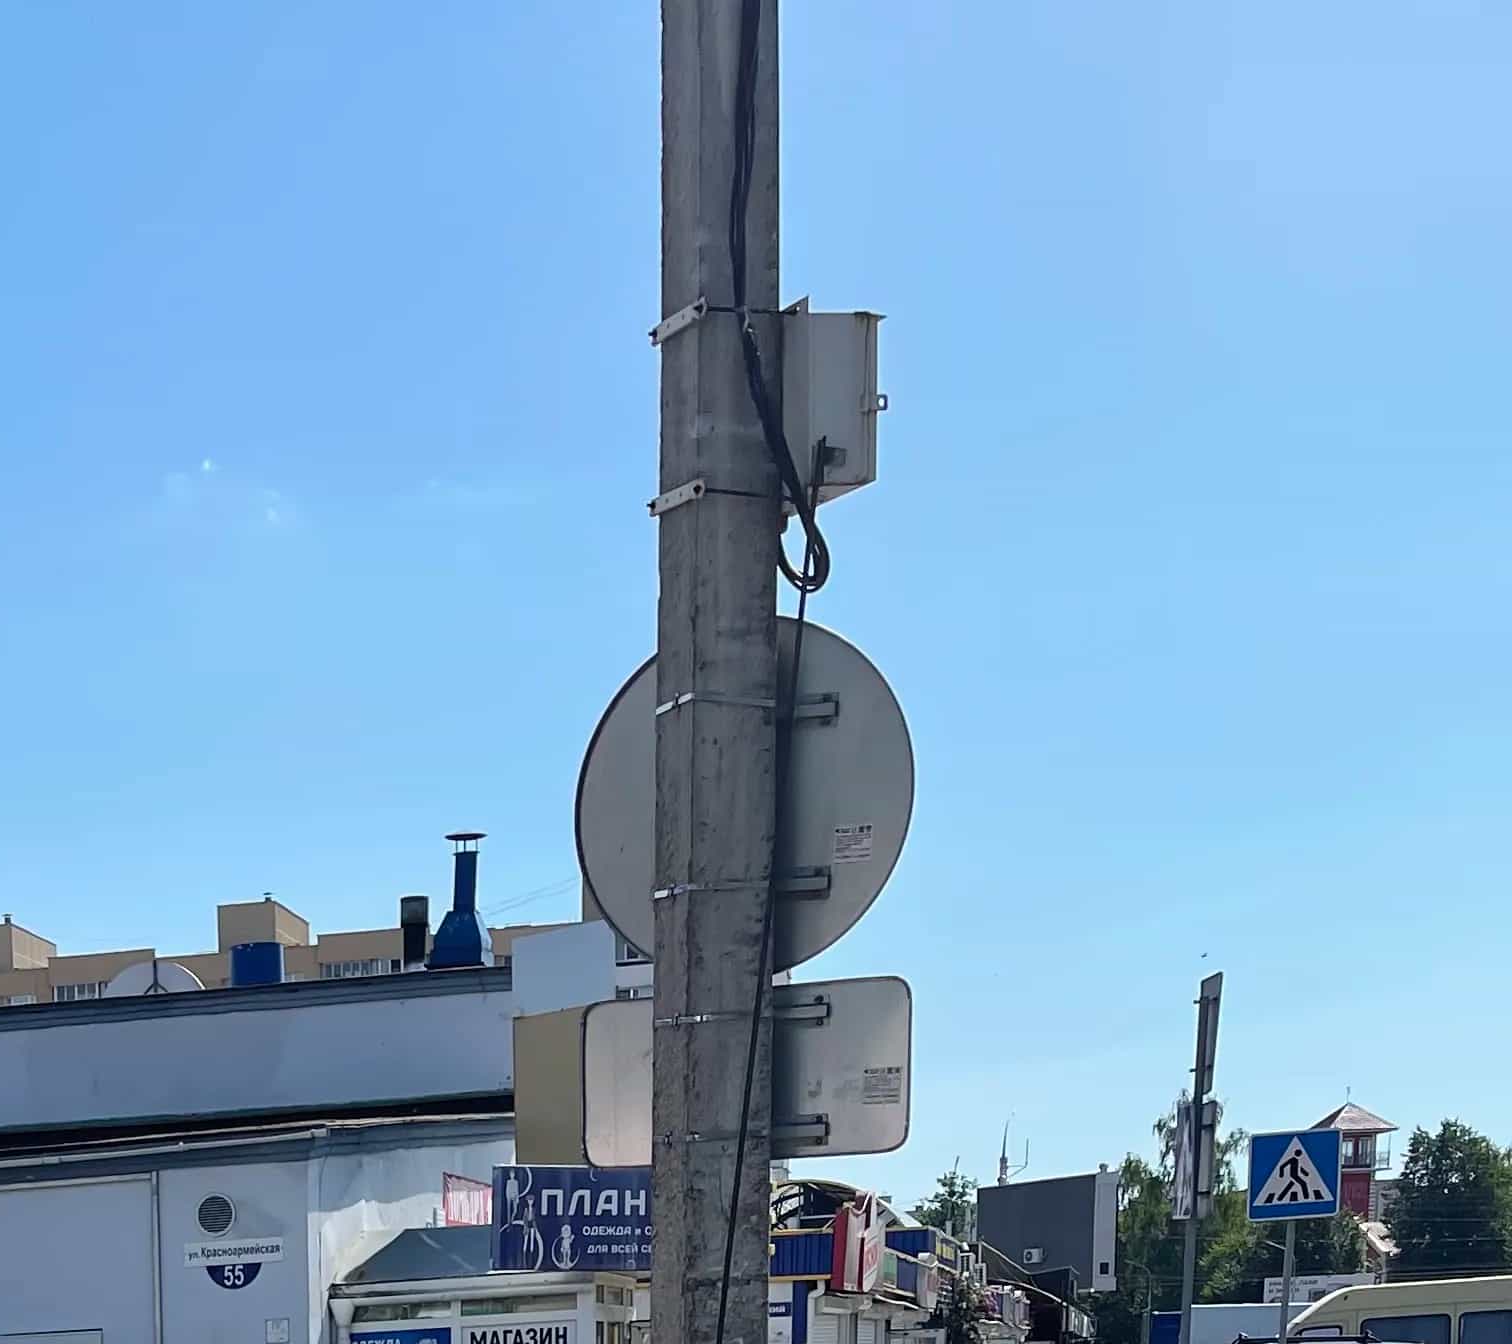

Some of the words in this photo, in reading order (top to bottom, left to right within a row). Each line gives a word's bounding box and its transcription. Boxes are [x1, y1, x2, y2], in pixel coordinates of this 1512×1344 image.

[582, 1225, 632, 1236] ОДЕЖДА
[201, 1244, 280, 1258] Красноармейская
[587, 1244, 609, 1254] ДЛЯ
[611, 1242, 639, 1254] ВСЕЙ
[224, 1265, 244, 1286] 55
